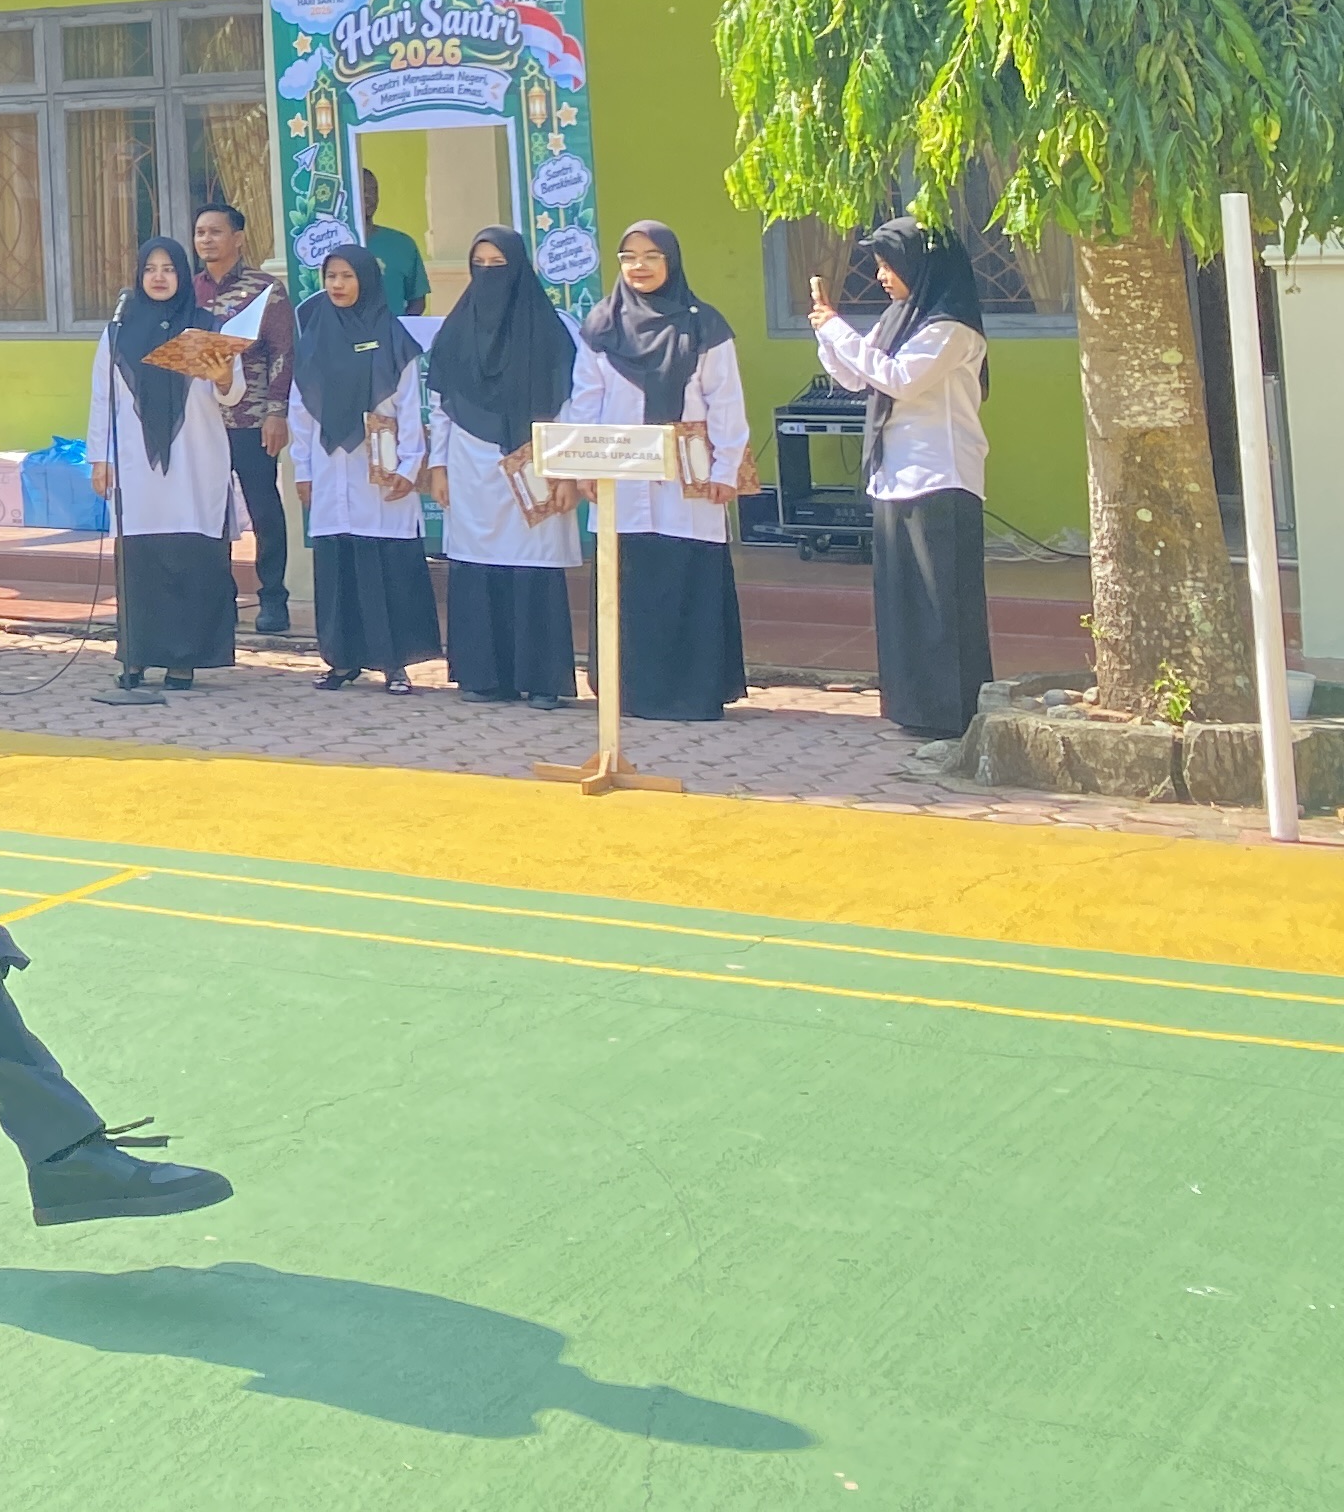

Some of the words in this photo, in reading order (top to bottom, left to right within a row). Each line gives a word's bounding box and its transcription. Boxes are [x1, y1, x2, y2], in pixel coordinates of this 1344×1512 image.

[335, 0, 417, 64] Hari
[388, 37, 462, 71] 2026
[371, 77, 401, 96] Santri
[402, 70, 455, 87] Menguatkan
[413, 84, 455, 98] Indonesia
[308, 226, 339, 246] Santri
[583, 436, 631, 445] BARISAN
[557, 450, 608, 459] PETUGAS
[610, 453, 662, 461] UPACARA
